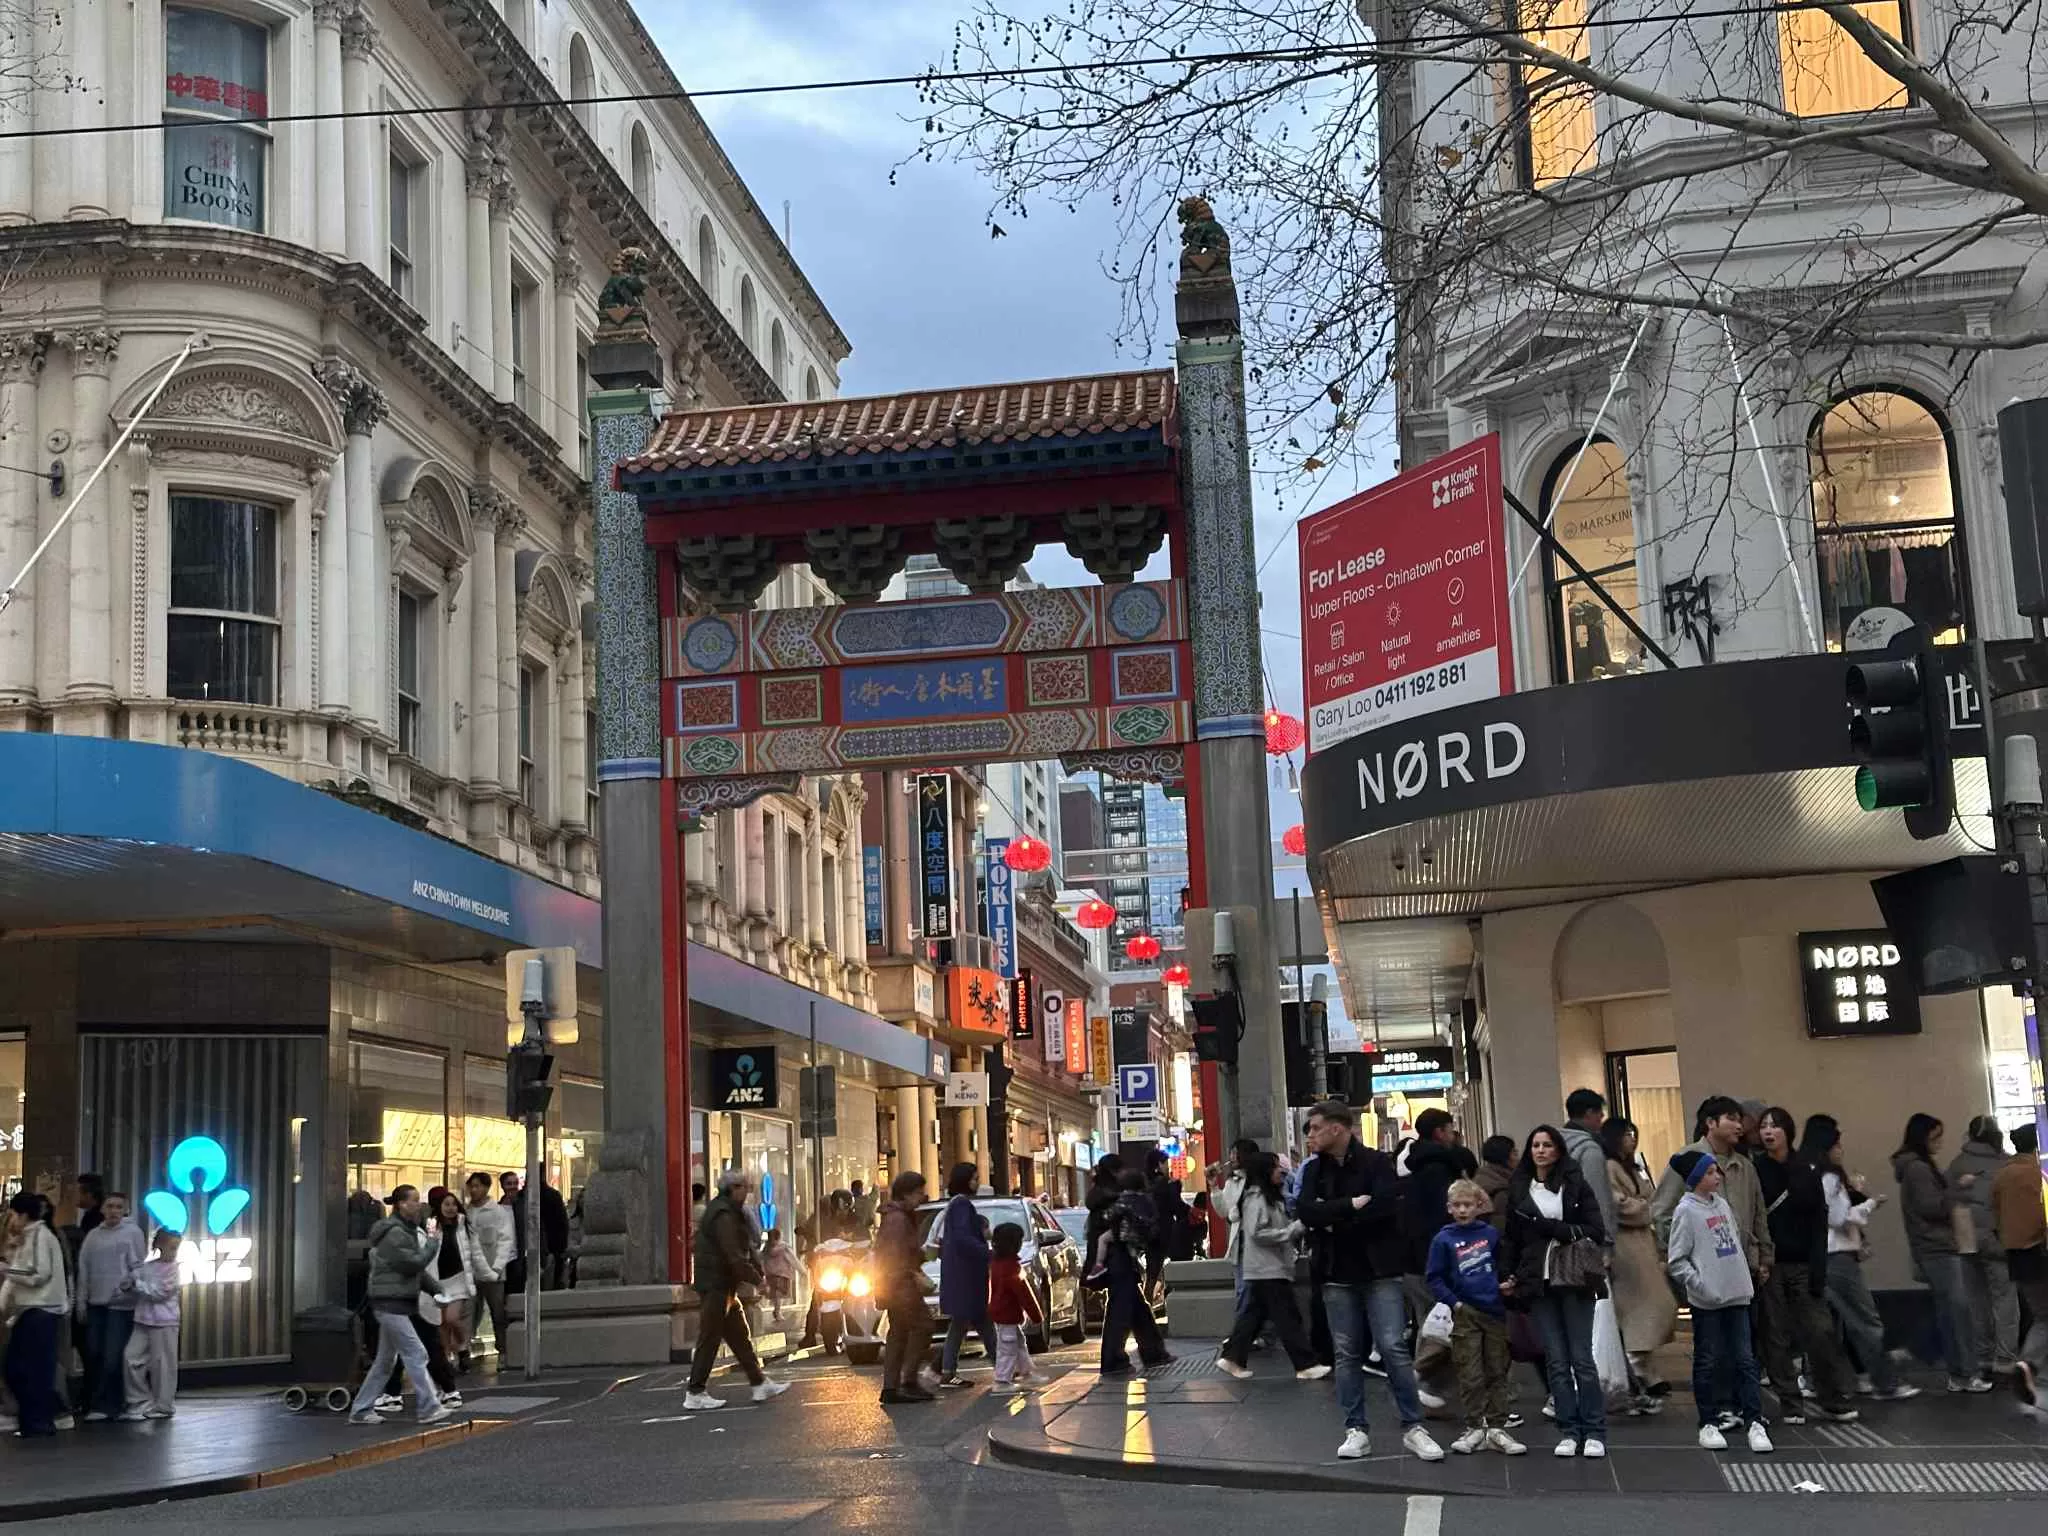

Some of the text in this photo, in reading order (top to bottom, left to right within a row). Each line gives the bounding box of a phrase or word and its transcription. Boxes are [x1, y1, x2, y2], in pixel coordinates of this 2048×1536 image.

[184, 164, 250, 196] CHINA
[182, 184, 253, 217] BOOKS
[1450, 463, 1478, 487] Knight
[1451, 481, 1475, 501] Frank
[1309, 547, 1386, 593] For Lease
[1310, 597, 1341, 620] Upper
[1343, 583, 1375, 607] Floors
[1385, 557, 1443, 590] Chinatown
[1445, 539, 1486, 566] Corner
[1451, 612, 1463, 628] All
[1381, 631, 1411, 653] Natural
[1436, 627, 1481, 653] amenities
[1314, 659, 1336, 677] Retail
[1342, 650, 1365, 668] Salon
[1387, 652, 1406, 671] light
[1330, 671, 1355, 689] Office
[1315, 662, 1467, 729] Gary Loo 0411 192 881
[1357, 722, 1527, 810] NØRD
[412, 880, 511, 926] ANZ CHINATOWN MELBOURNE
[990, 844, 1009, 968] POKIES
[1813, 944, 1901, 970] NØRD
[725, 1087, 765, 1104] ANZ
[955, 1092, 978, 1100] KENO
[1127, 1070, 1149, 1099] P
[144, 1237, 253, 1286] NZ
